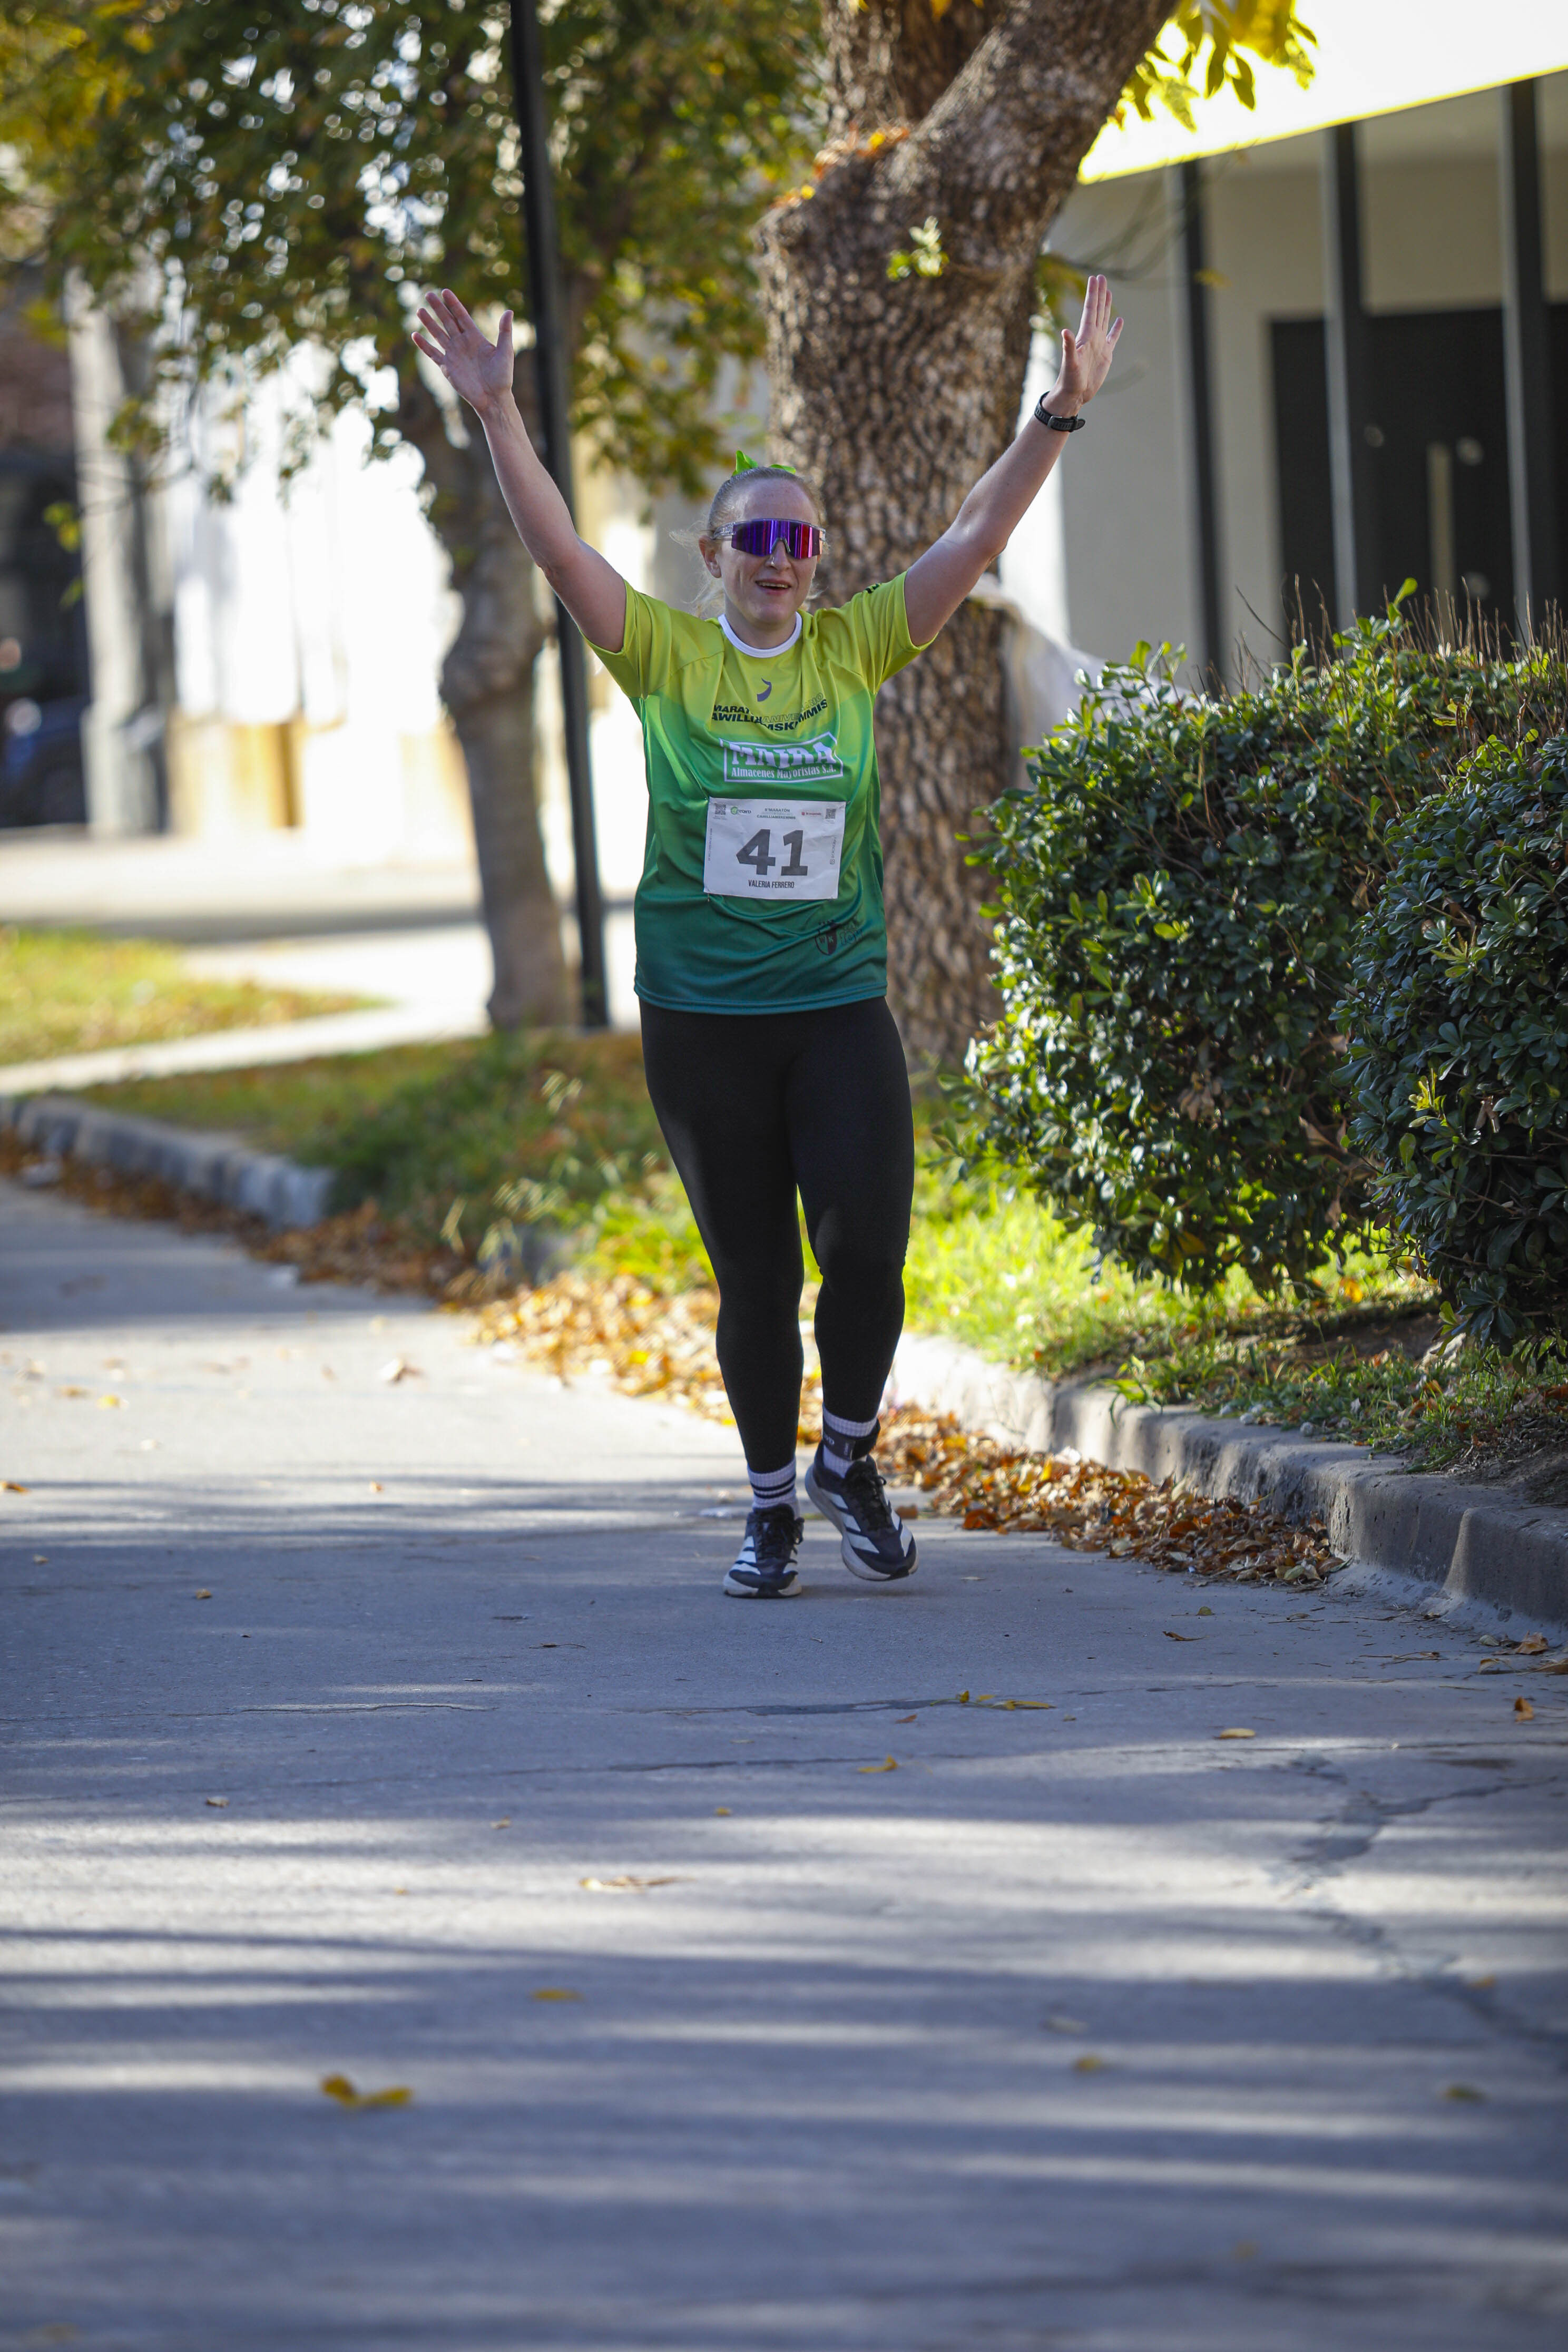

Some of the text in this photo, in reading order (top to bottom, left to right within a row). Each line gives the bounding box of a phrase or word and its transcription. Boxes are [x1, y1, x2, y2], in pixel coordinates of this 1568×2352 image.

[731, 763, 837, 780] Almacenes Mayoristas S.A.
[736, 829, 808, 876] 41
